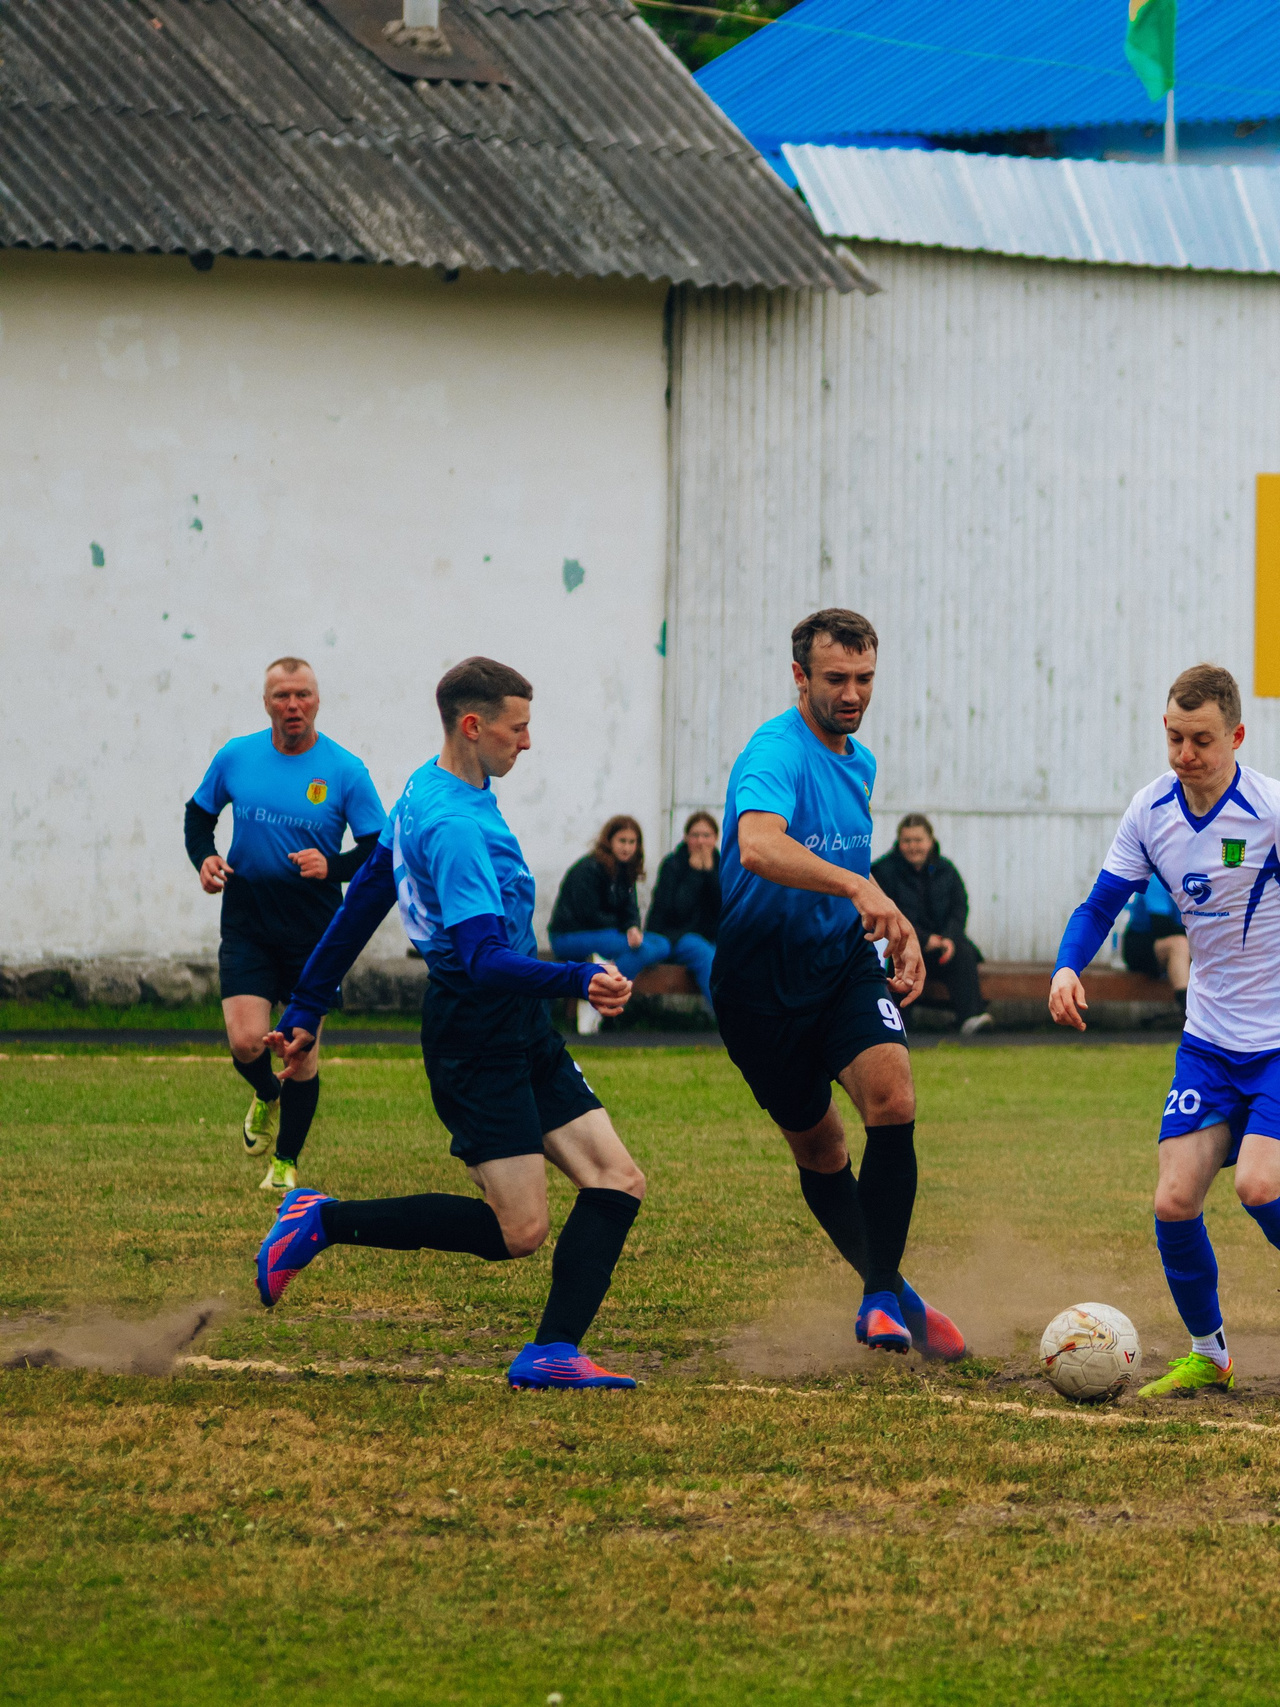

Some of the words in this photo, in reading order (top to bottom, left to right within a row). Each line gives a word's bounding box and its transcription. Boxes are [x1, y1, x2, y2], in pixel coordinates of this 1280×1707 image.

[804, 832, 831, 852] ФК
[831, 832, 872, 852] Витя
[1163, 1088, 1202, 1117] 20
